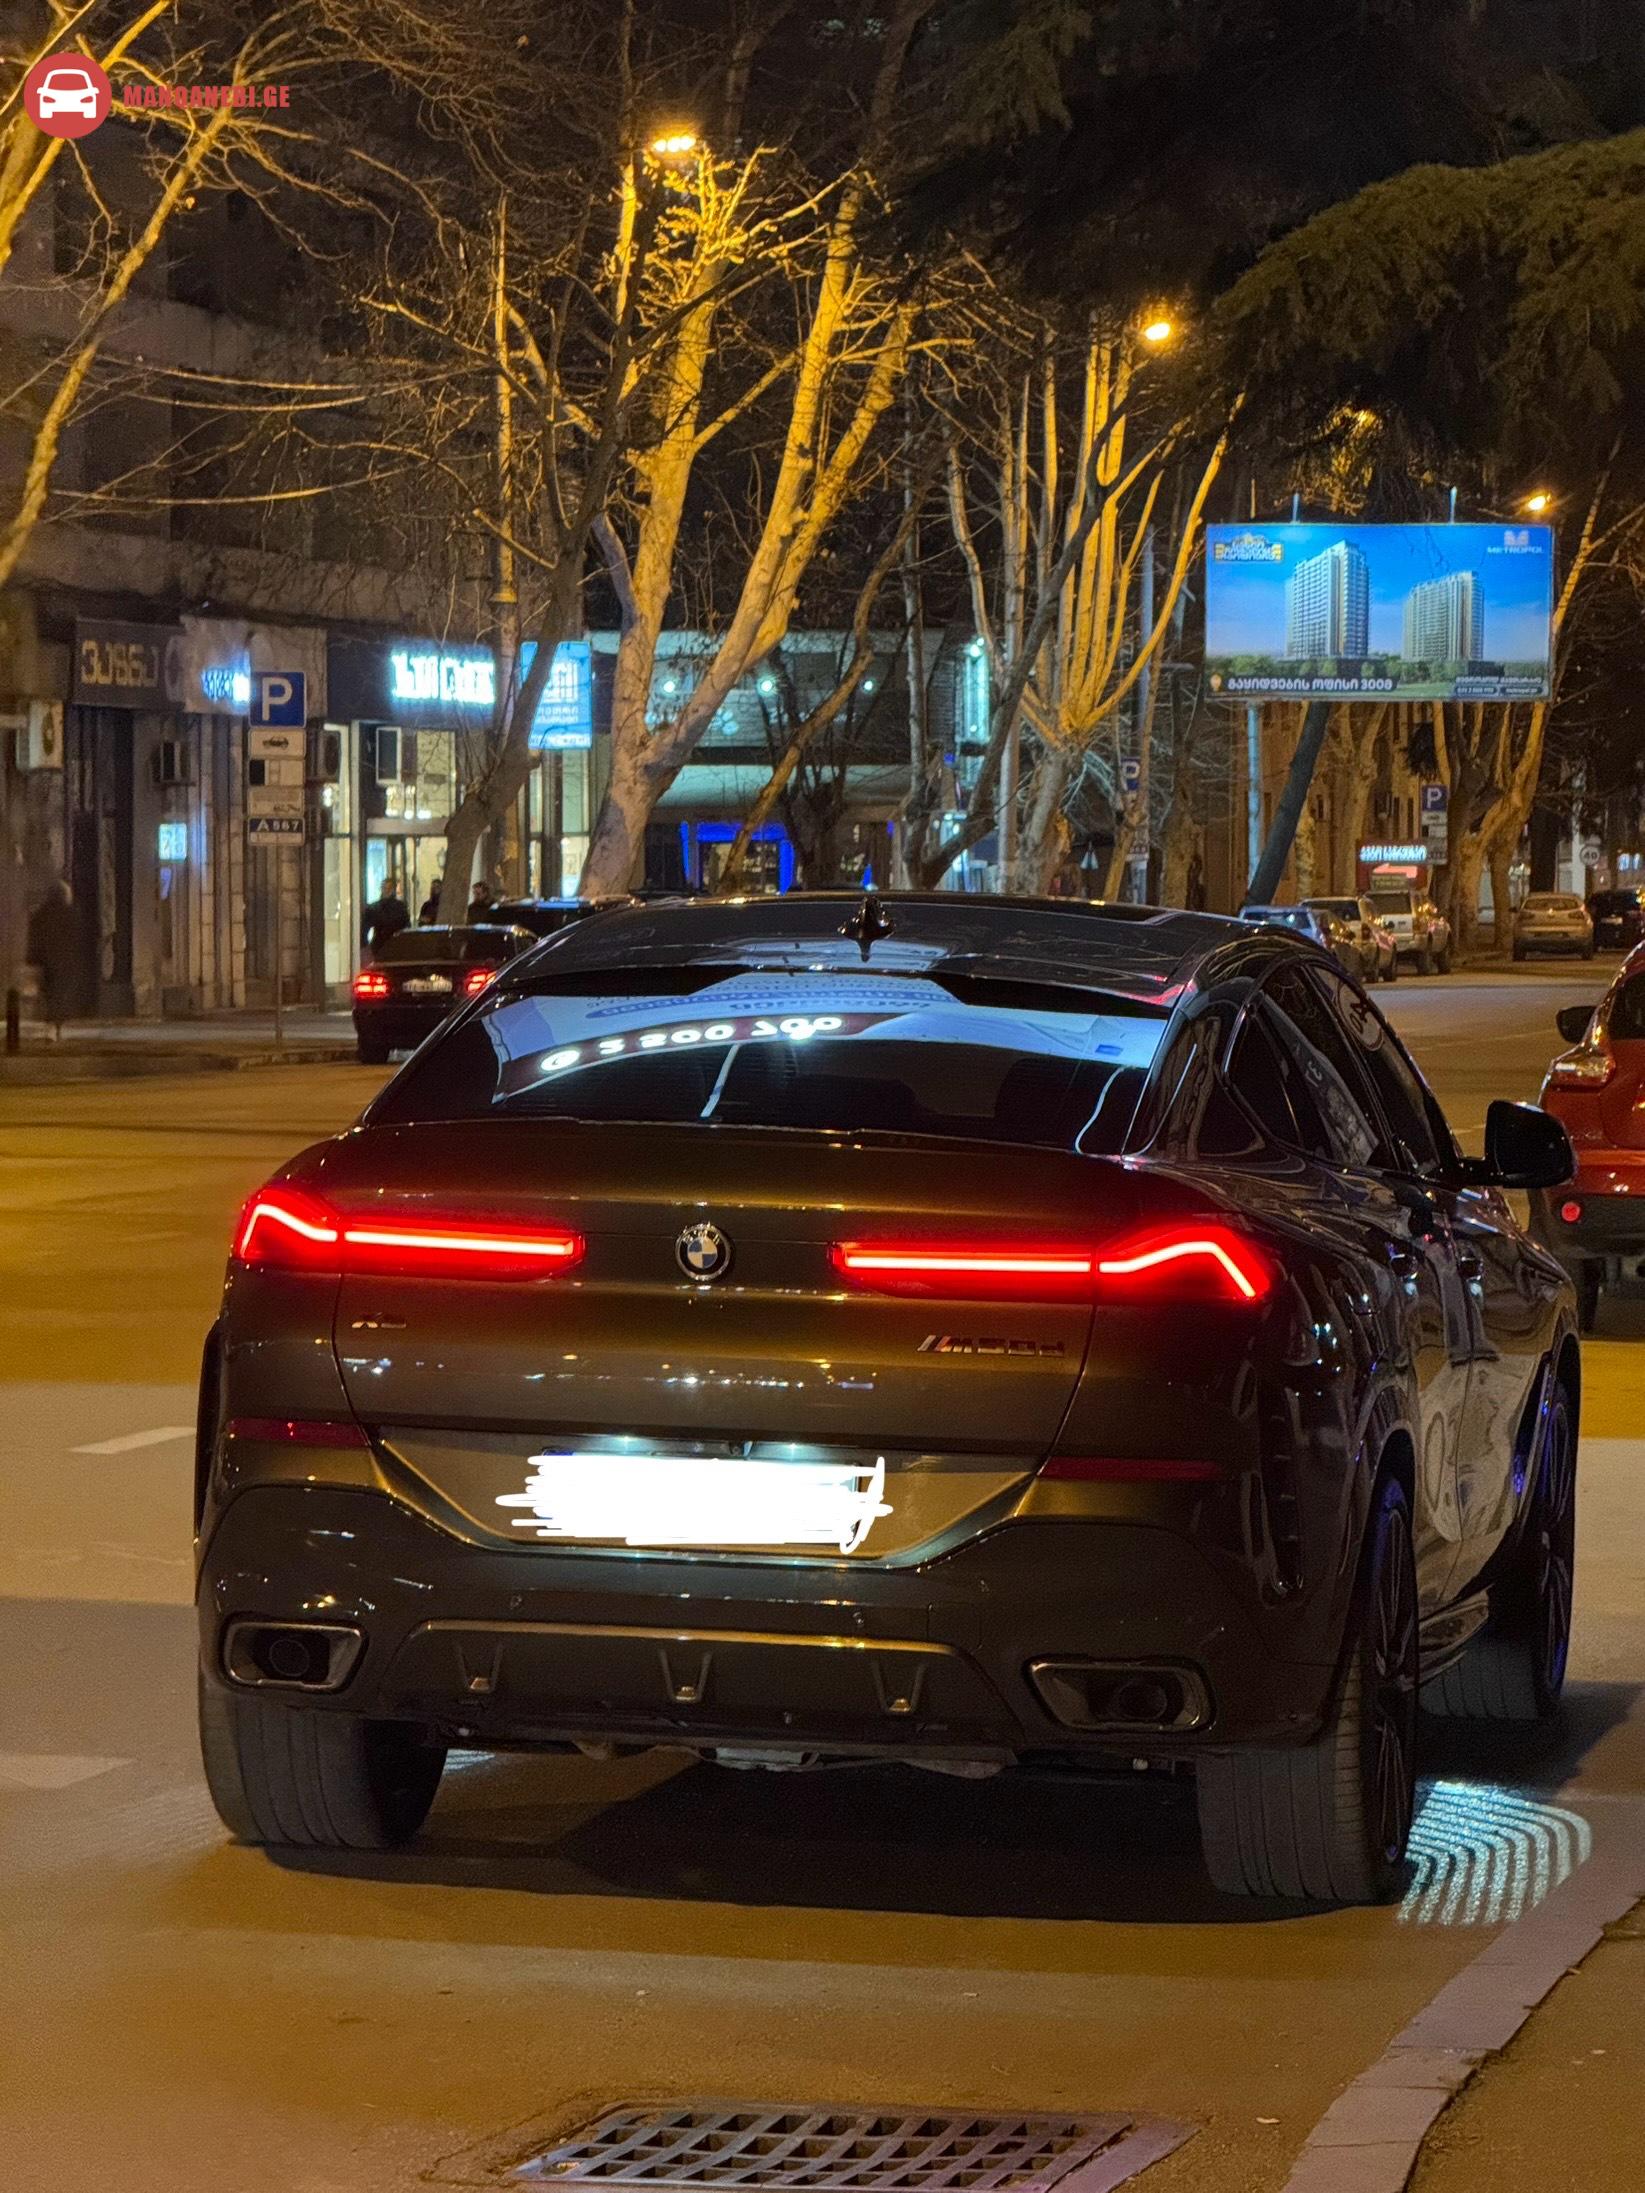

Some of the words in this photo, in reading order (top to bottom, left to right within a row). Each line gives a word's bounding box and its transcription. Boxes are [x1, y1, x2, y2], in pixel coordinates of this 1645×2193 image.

[1227, 677, 1310, 691] გაყიდვების
[1312, 677, 1358, 691] ოფისი
[262, 676, 293, 721] P
[1426, 787, 1442, 809] P
